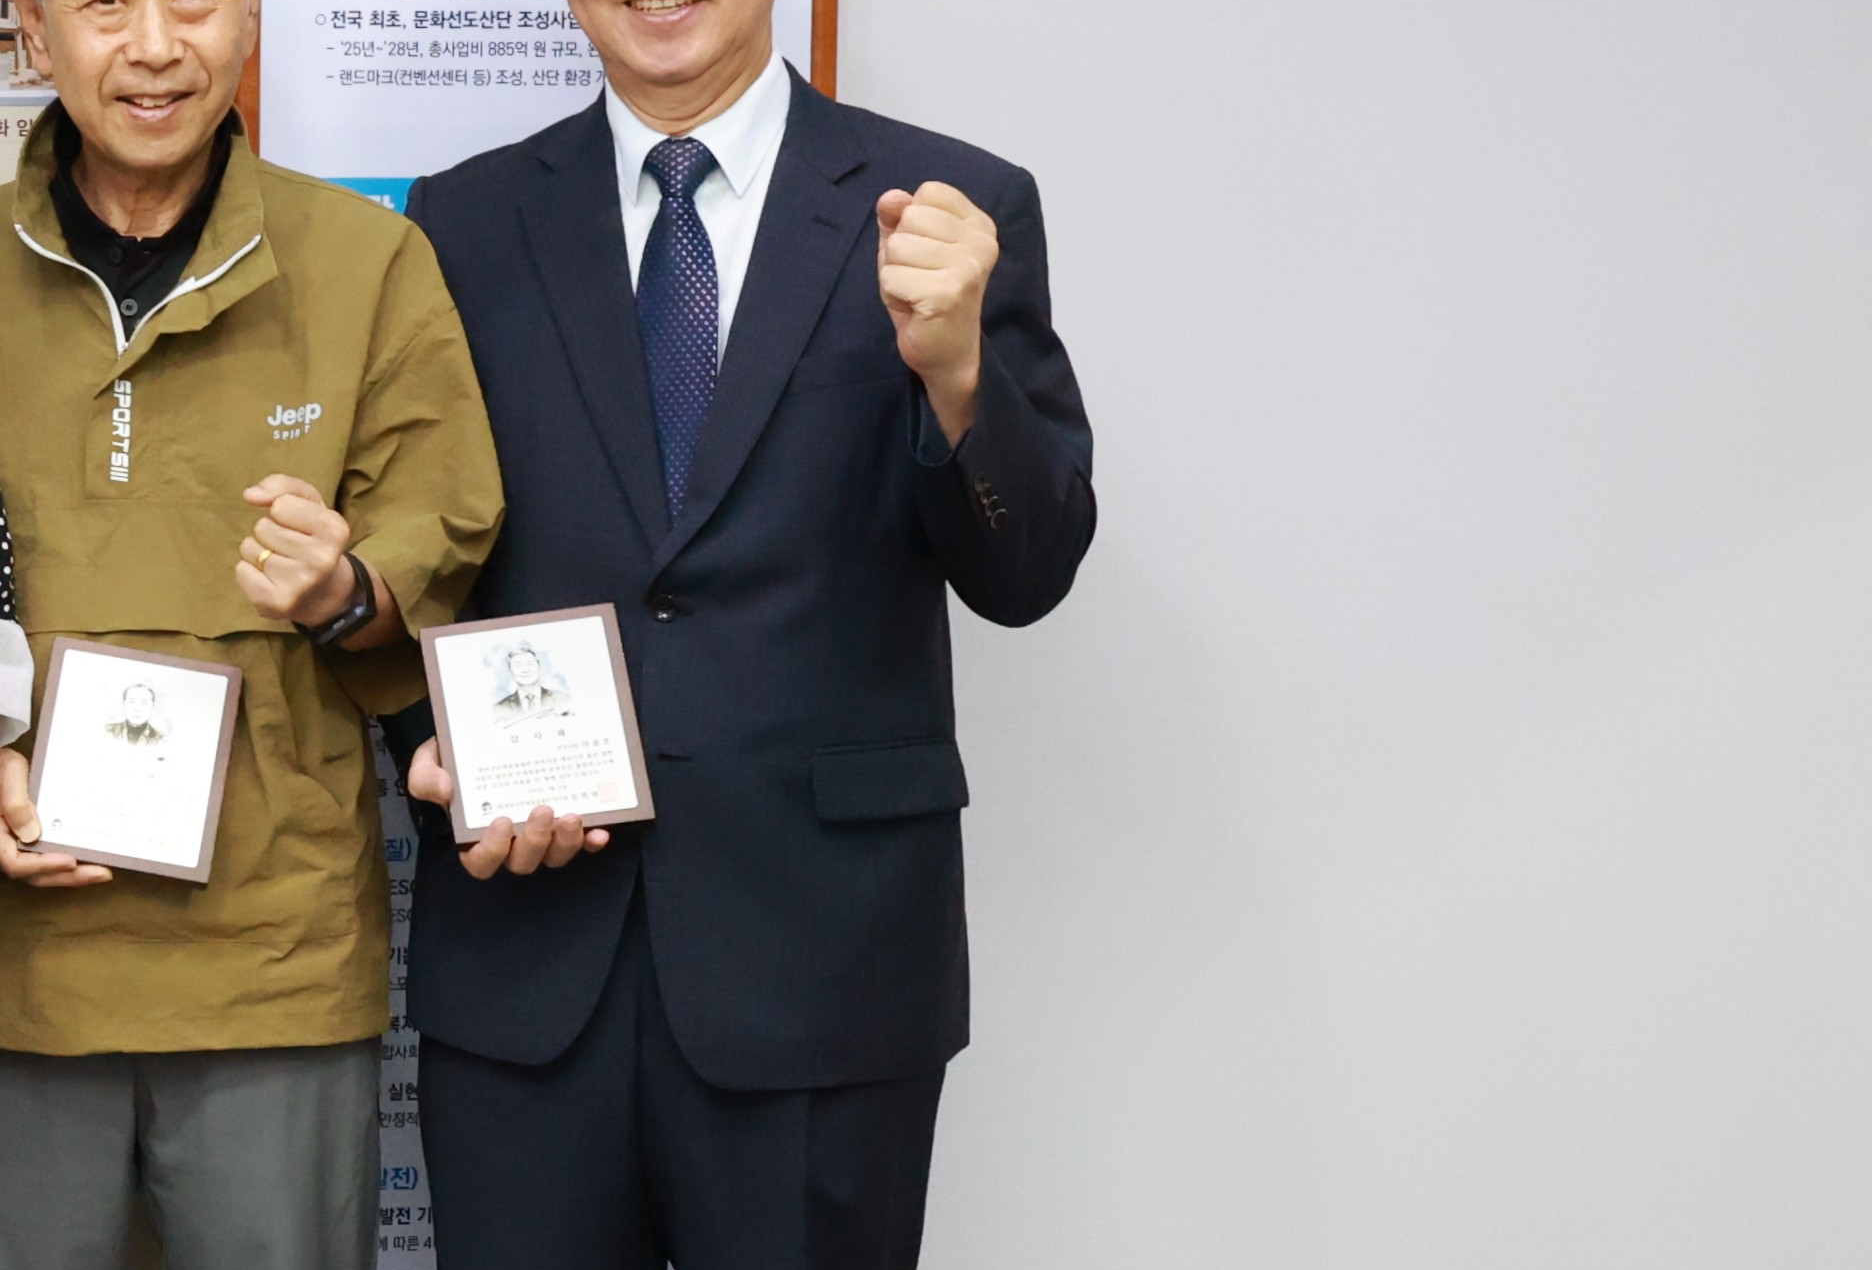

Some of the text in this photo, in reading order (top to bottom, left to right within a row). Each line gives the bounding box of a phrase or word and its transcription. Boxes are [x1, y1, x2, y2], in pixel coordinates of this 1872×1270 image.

[330, 9, 513, 30] 전국 최초, 문화선도산단
[427, 40, 528, 58] 총사업비 885억
[530, 69, 560, 87] 산단
[267, 402, 322, 427] Jeep
